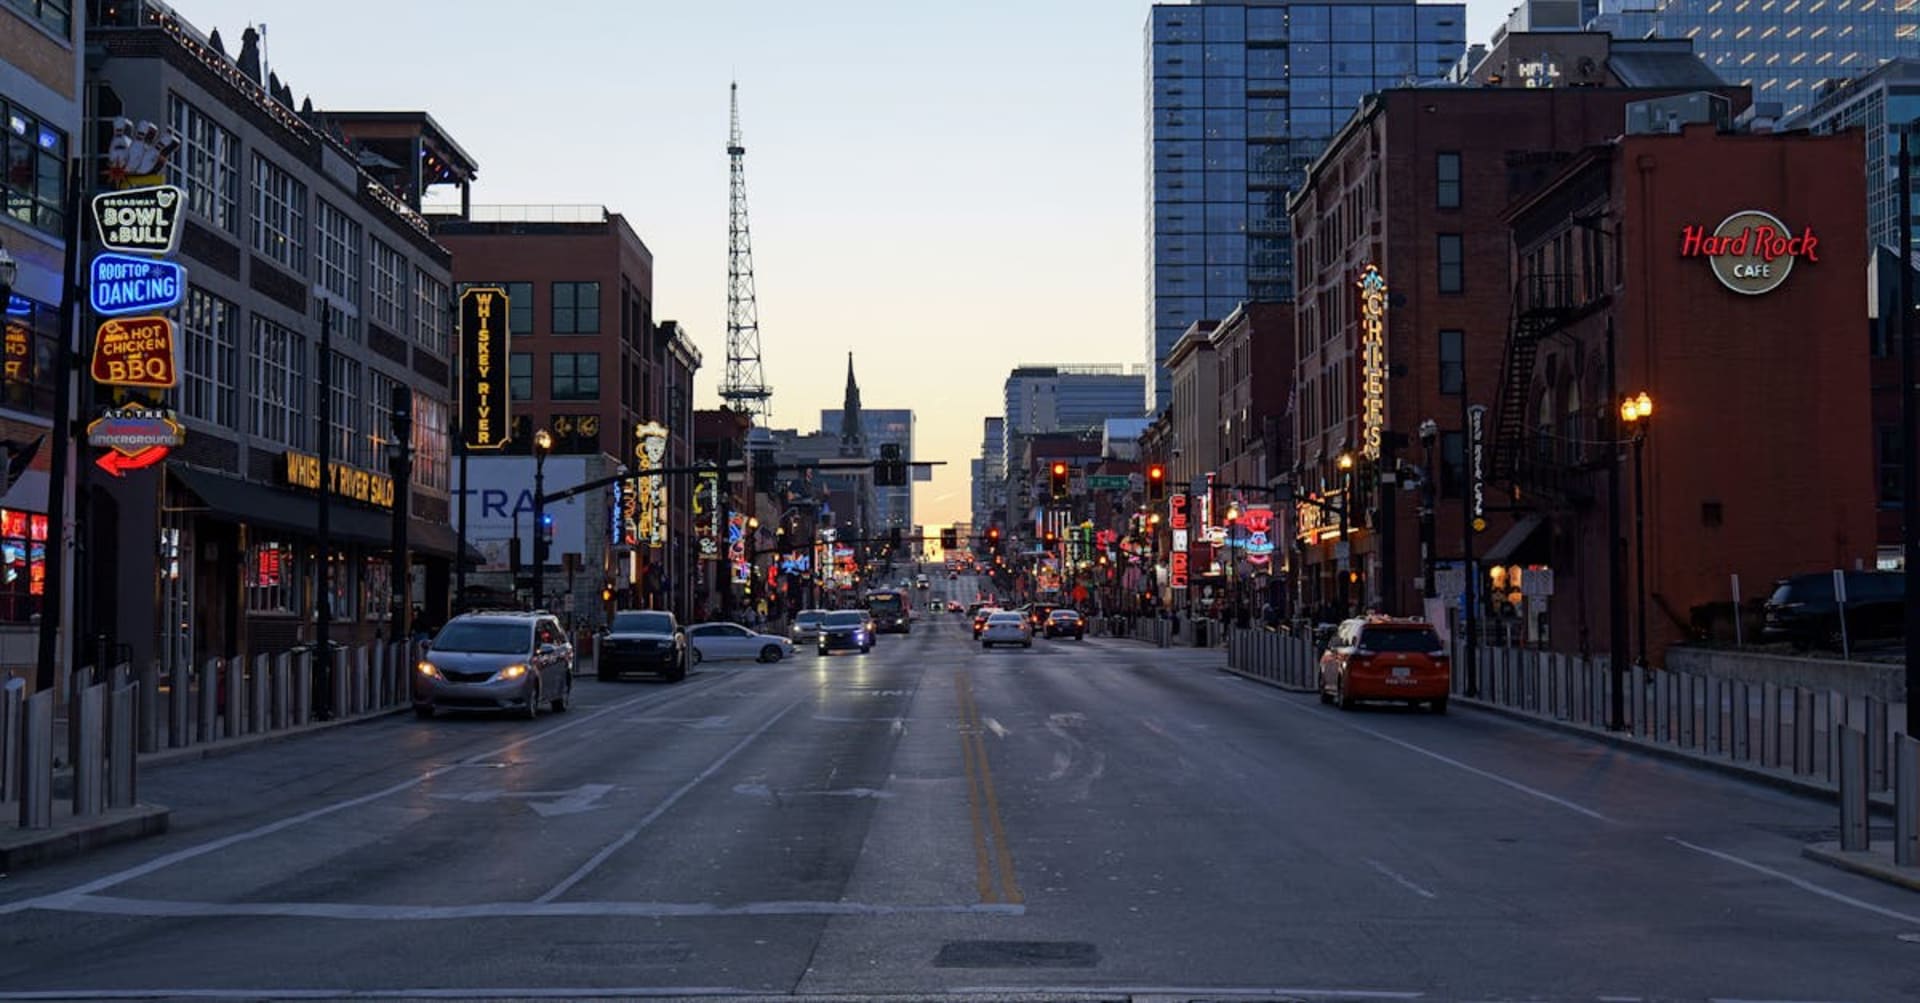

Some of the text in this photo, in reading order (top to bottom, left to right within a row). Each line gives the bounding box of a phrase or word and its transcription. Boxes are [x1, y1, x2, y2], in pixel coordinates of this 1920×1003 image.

[104, 207, 169, 226] BOWL
[1682, 225, 1819, 261] Hard Rock
[98, 263, 150, 280] ROOFTOP
[1733, 264, 1770, 279] CAFE
[99, 276, 175, 306] DANCING
[131, 325, 162, 340] HOT
[103, 337, 166, 356] CHICKEN
[107, 357, 167, 382] BBQ
[476, 293, 492, 443] WHISKEY RIVER
[104, 410, 121, 418] AT
[287, 451, 395, 508] WHISY RIVER SALO
